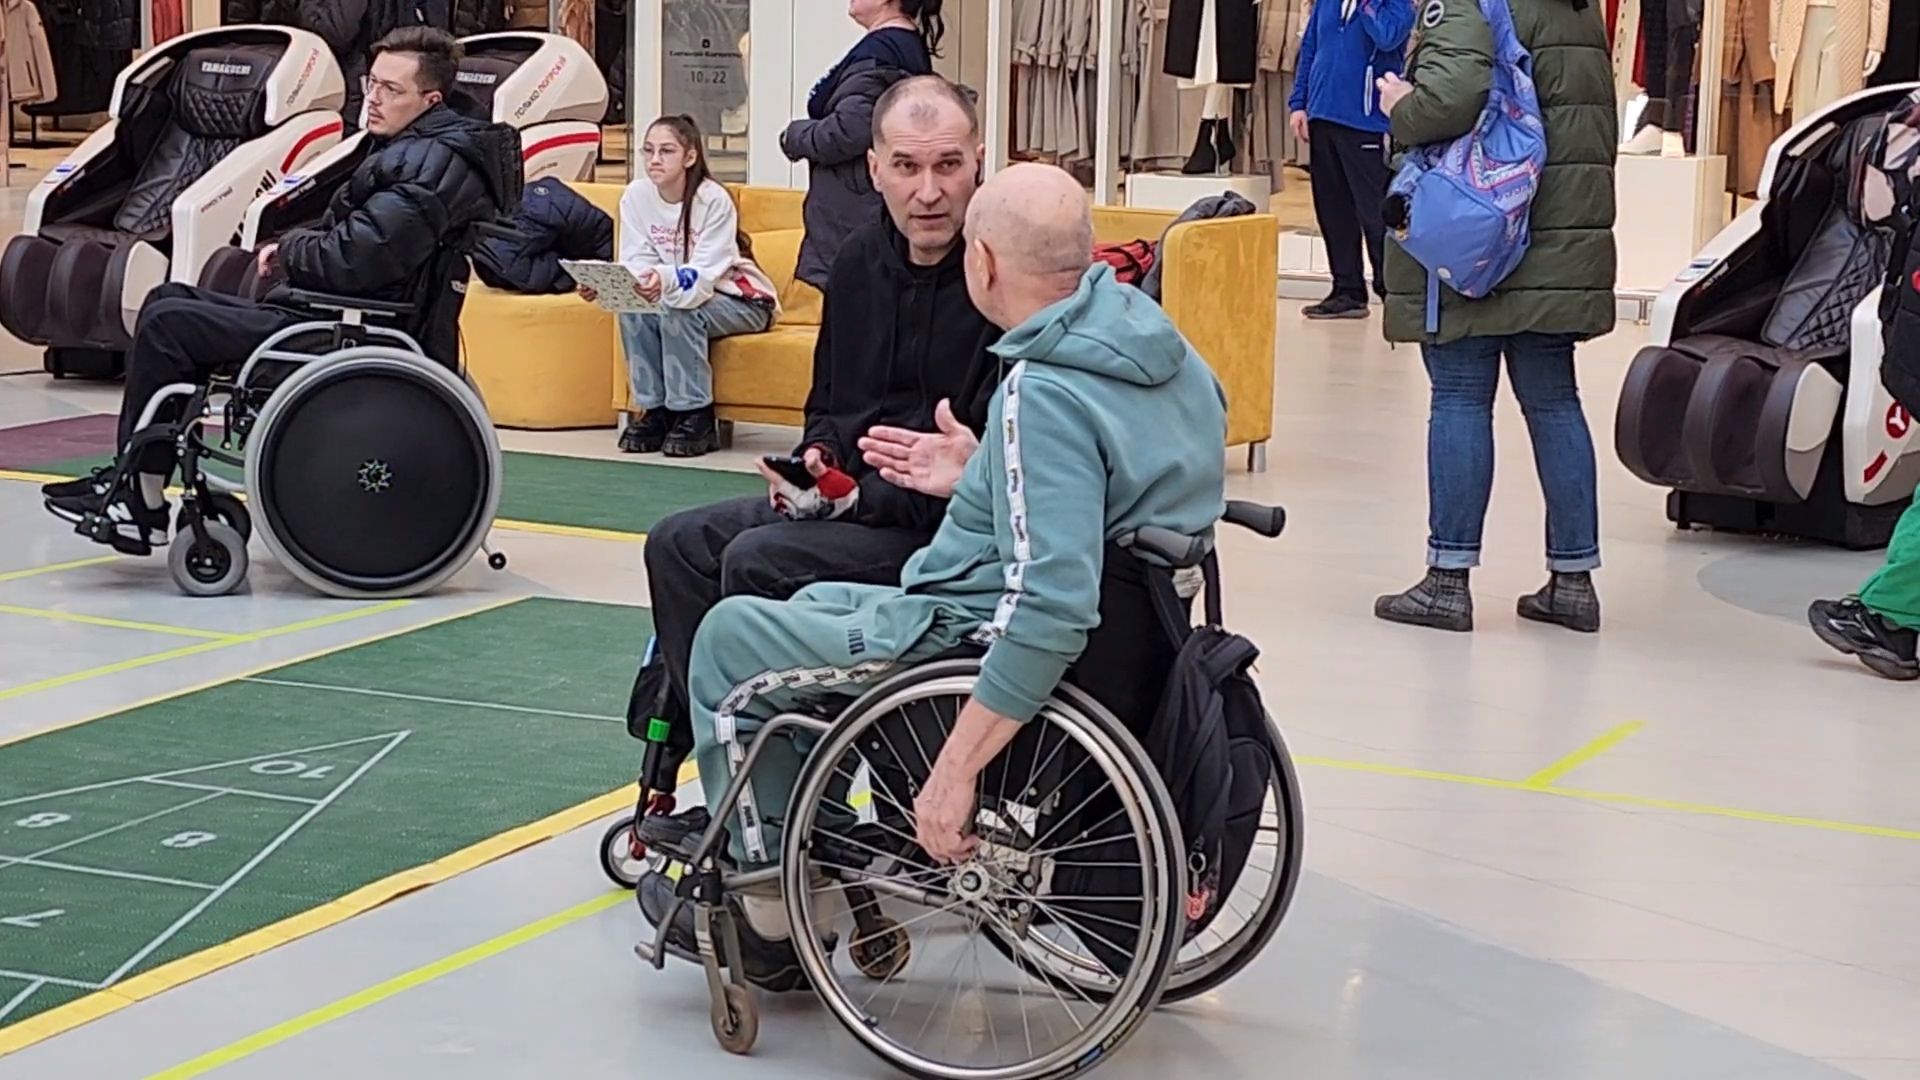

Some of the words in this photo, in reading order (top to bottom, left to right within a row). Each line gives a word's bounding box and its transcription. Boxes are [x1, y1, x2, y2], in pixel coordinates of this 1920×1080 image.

[690, 70, 704, 83] 10
[712, 70, 727, 84] 22
[250, 760, 335, 779] 10
[15, 812, 71, 828] 8
[161, 831, 218, 848] 8
